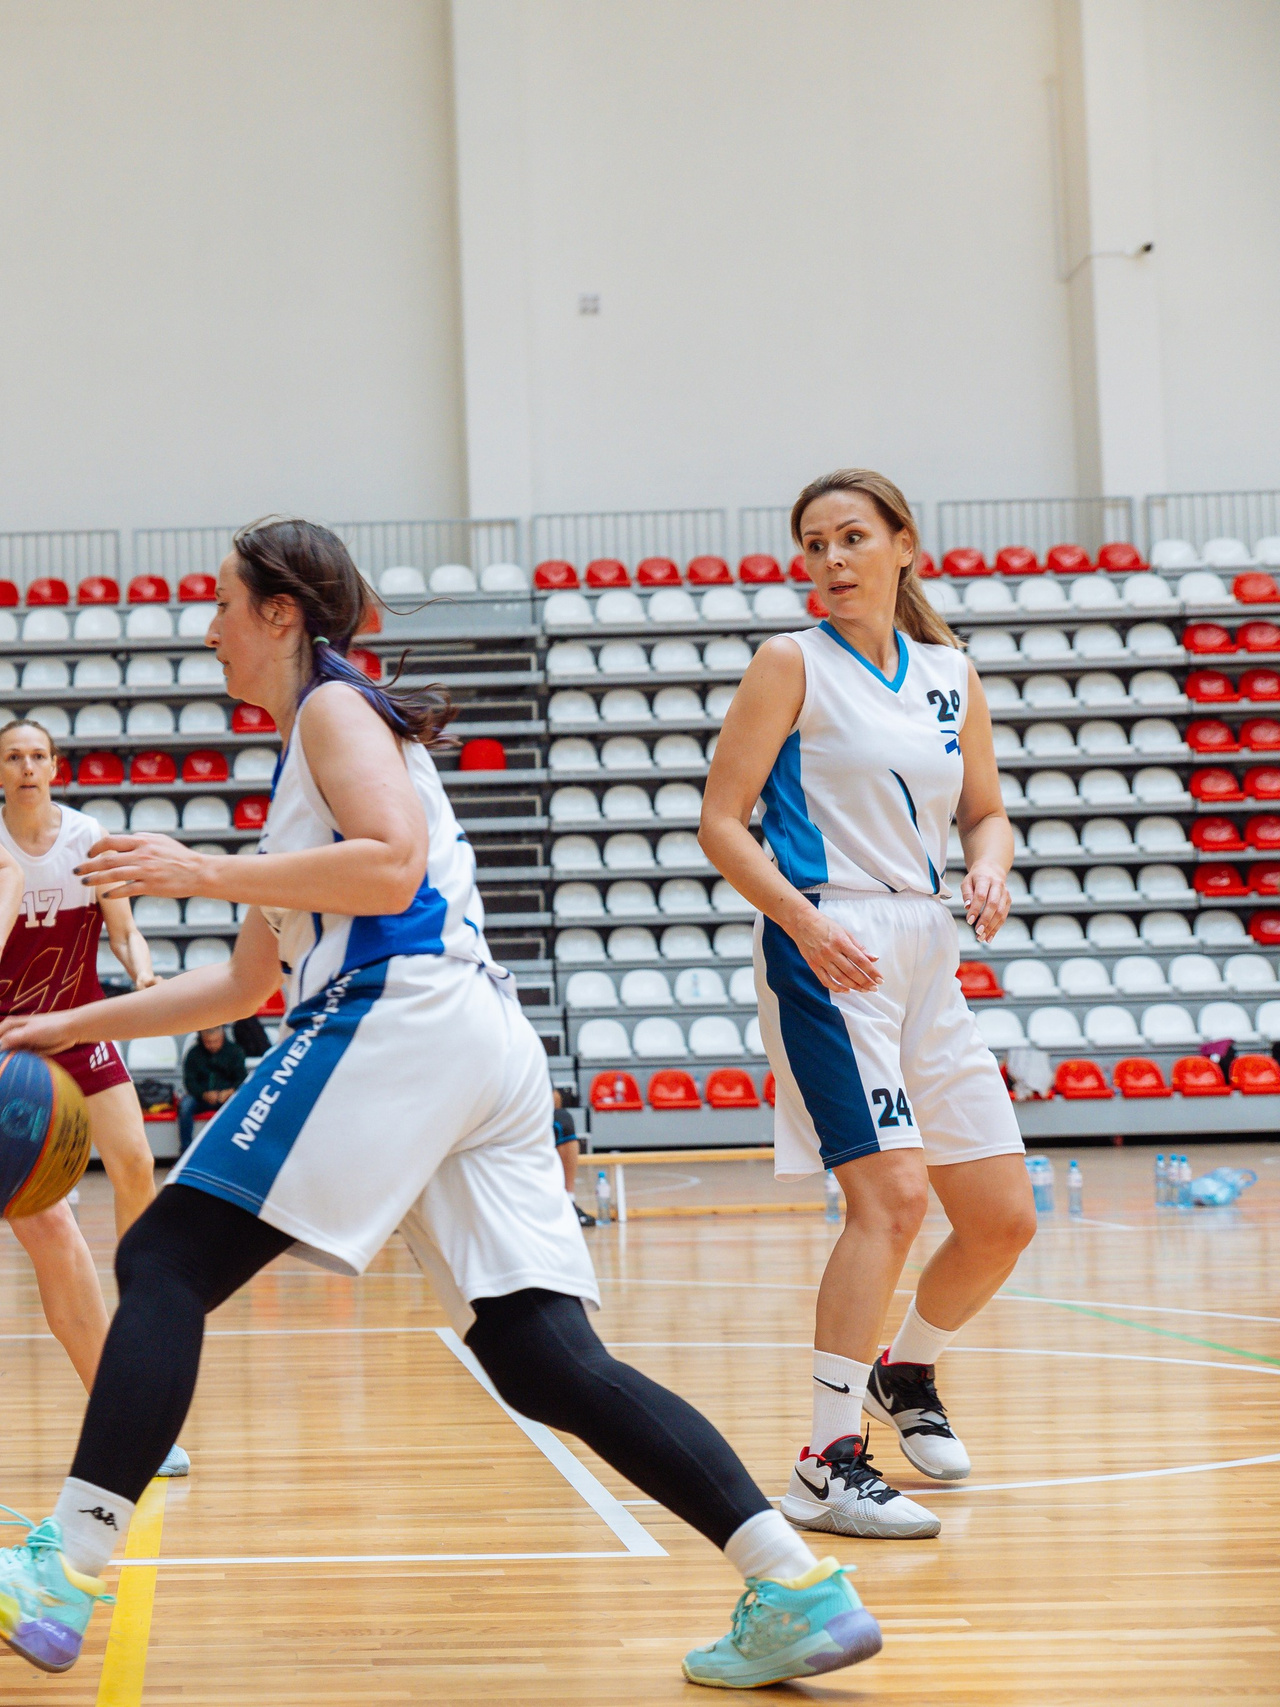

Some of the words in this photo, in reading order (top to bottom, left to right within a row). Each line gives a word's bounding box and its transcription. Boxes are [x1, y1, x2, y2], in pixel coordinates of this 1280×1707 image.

[22, 888, 64, 928] 17
[231, 1084, 281, 1151] MBC
[871, 1087, 914, 1129] 24
